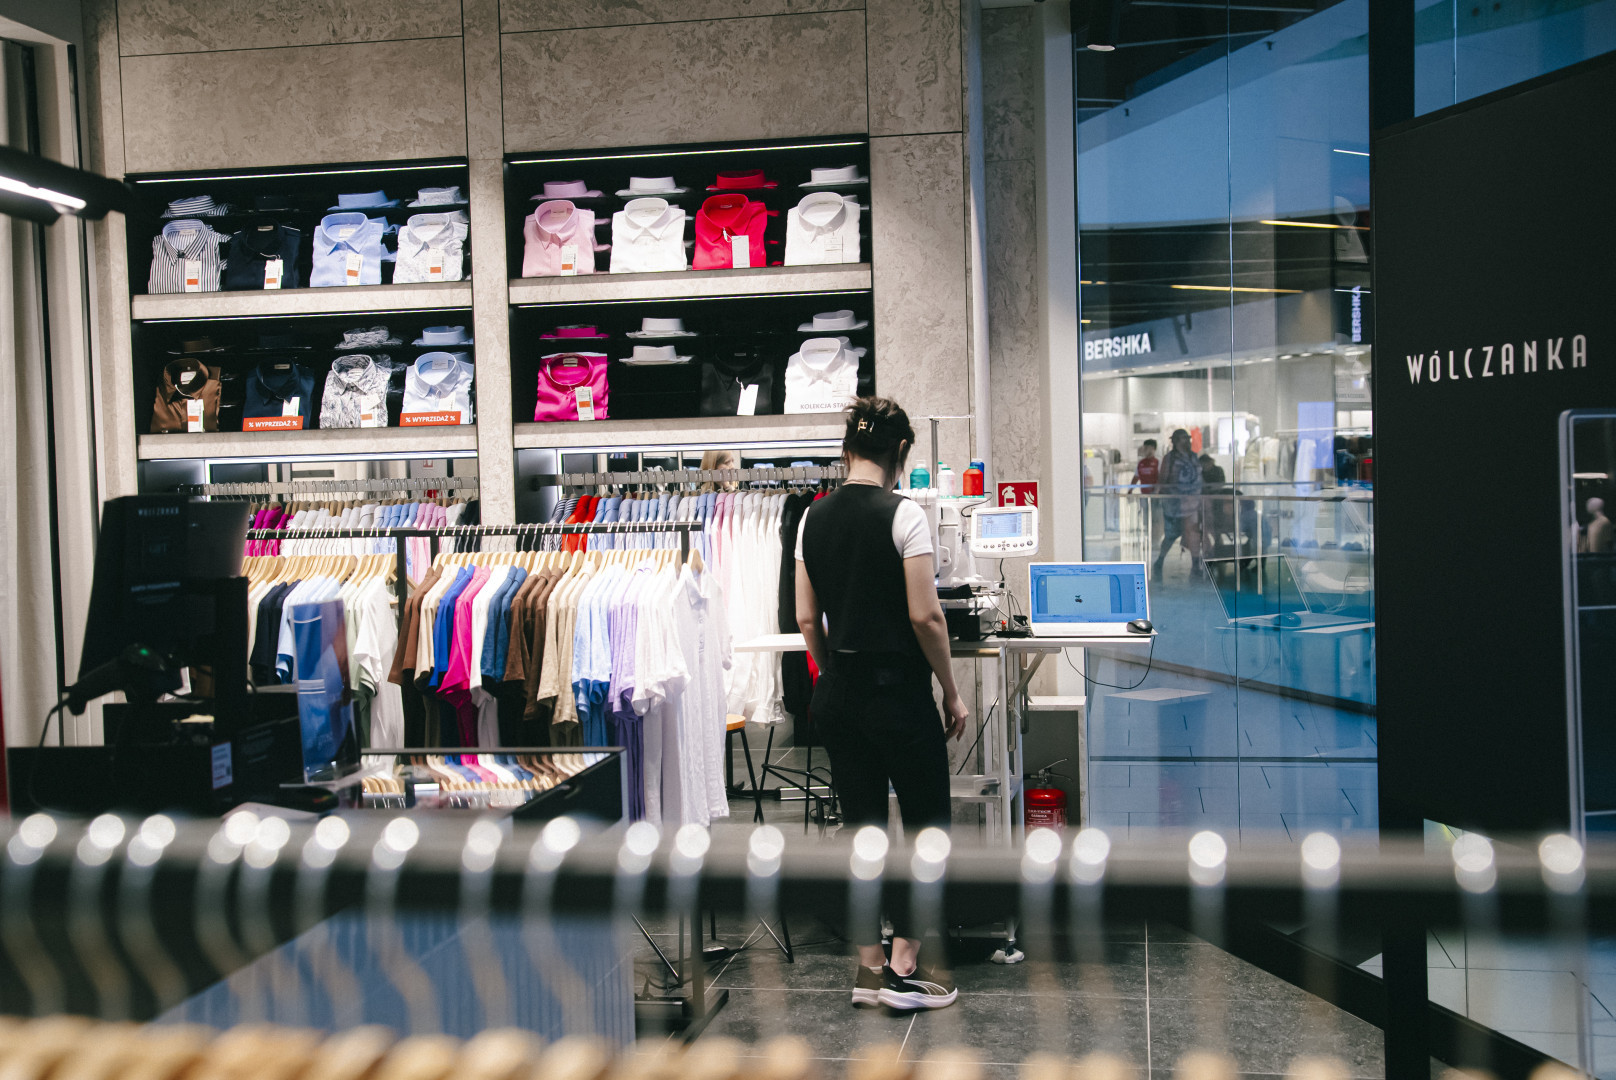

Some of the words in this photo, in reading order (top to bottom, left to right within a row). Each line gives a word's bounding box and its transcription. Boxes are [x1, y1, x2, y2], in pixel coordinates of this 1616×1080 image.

[1085, 332, 1152, 361] BERSHKA
[1407, 334, 1587, 385] WÓLCZANKA
[255, 420, 291, 428] WYPRZEDAŻ
[412, 414, 449, 423] WYPRZEDAŻ
